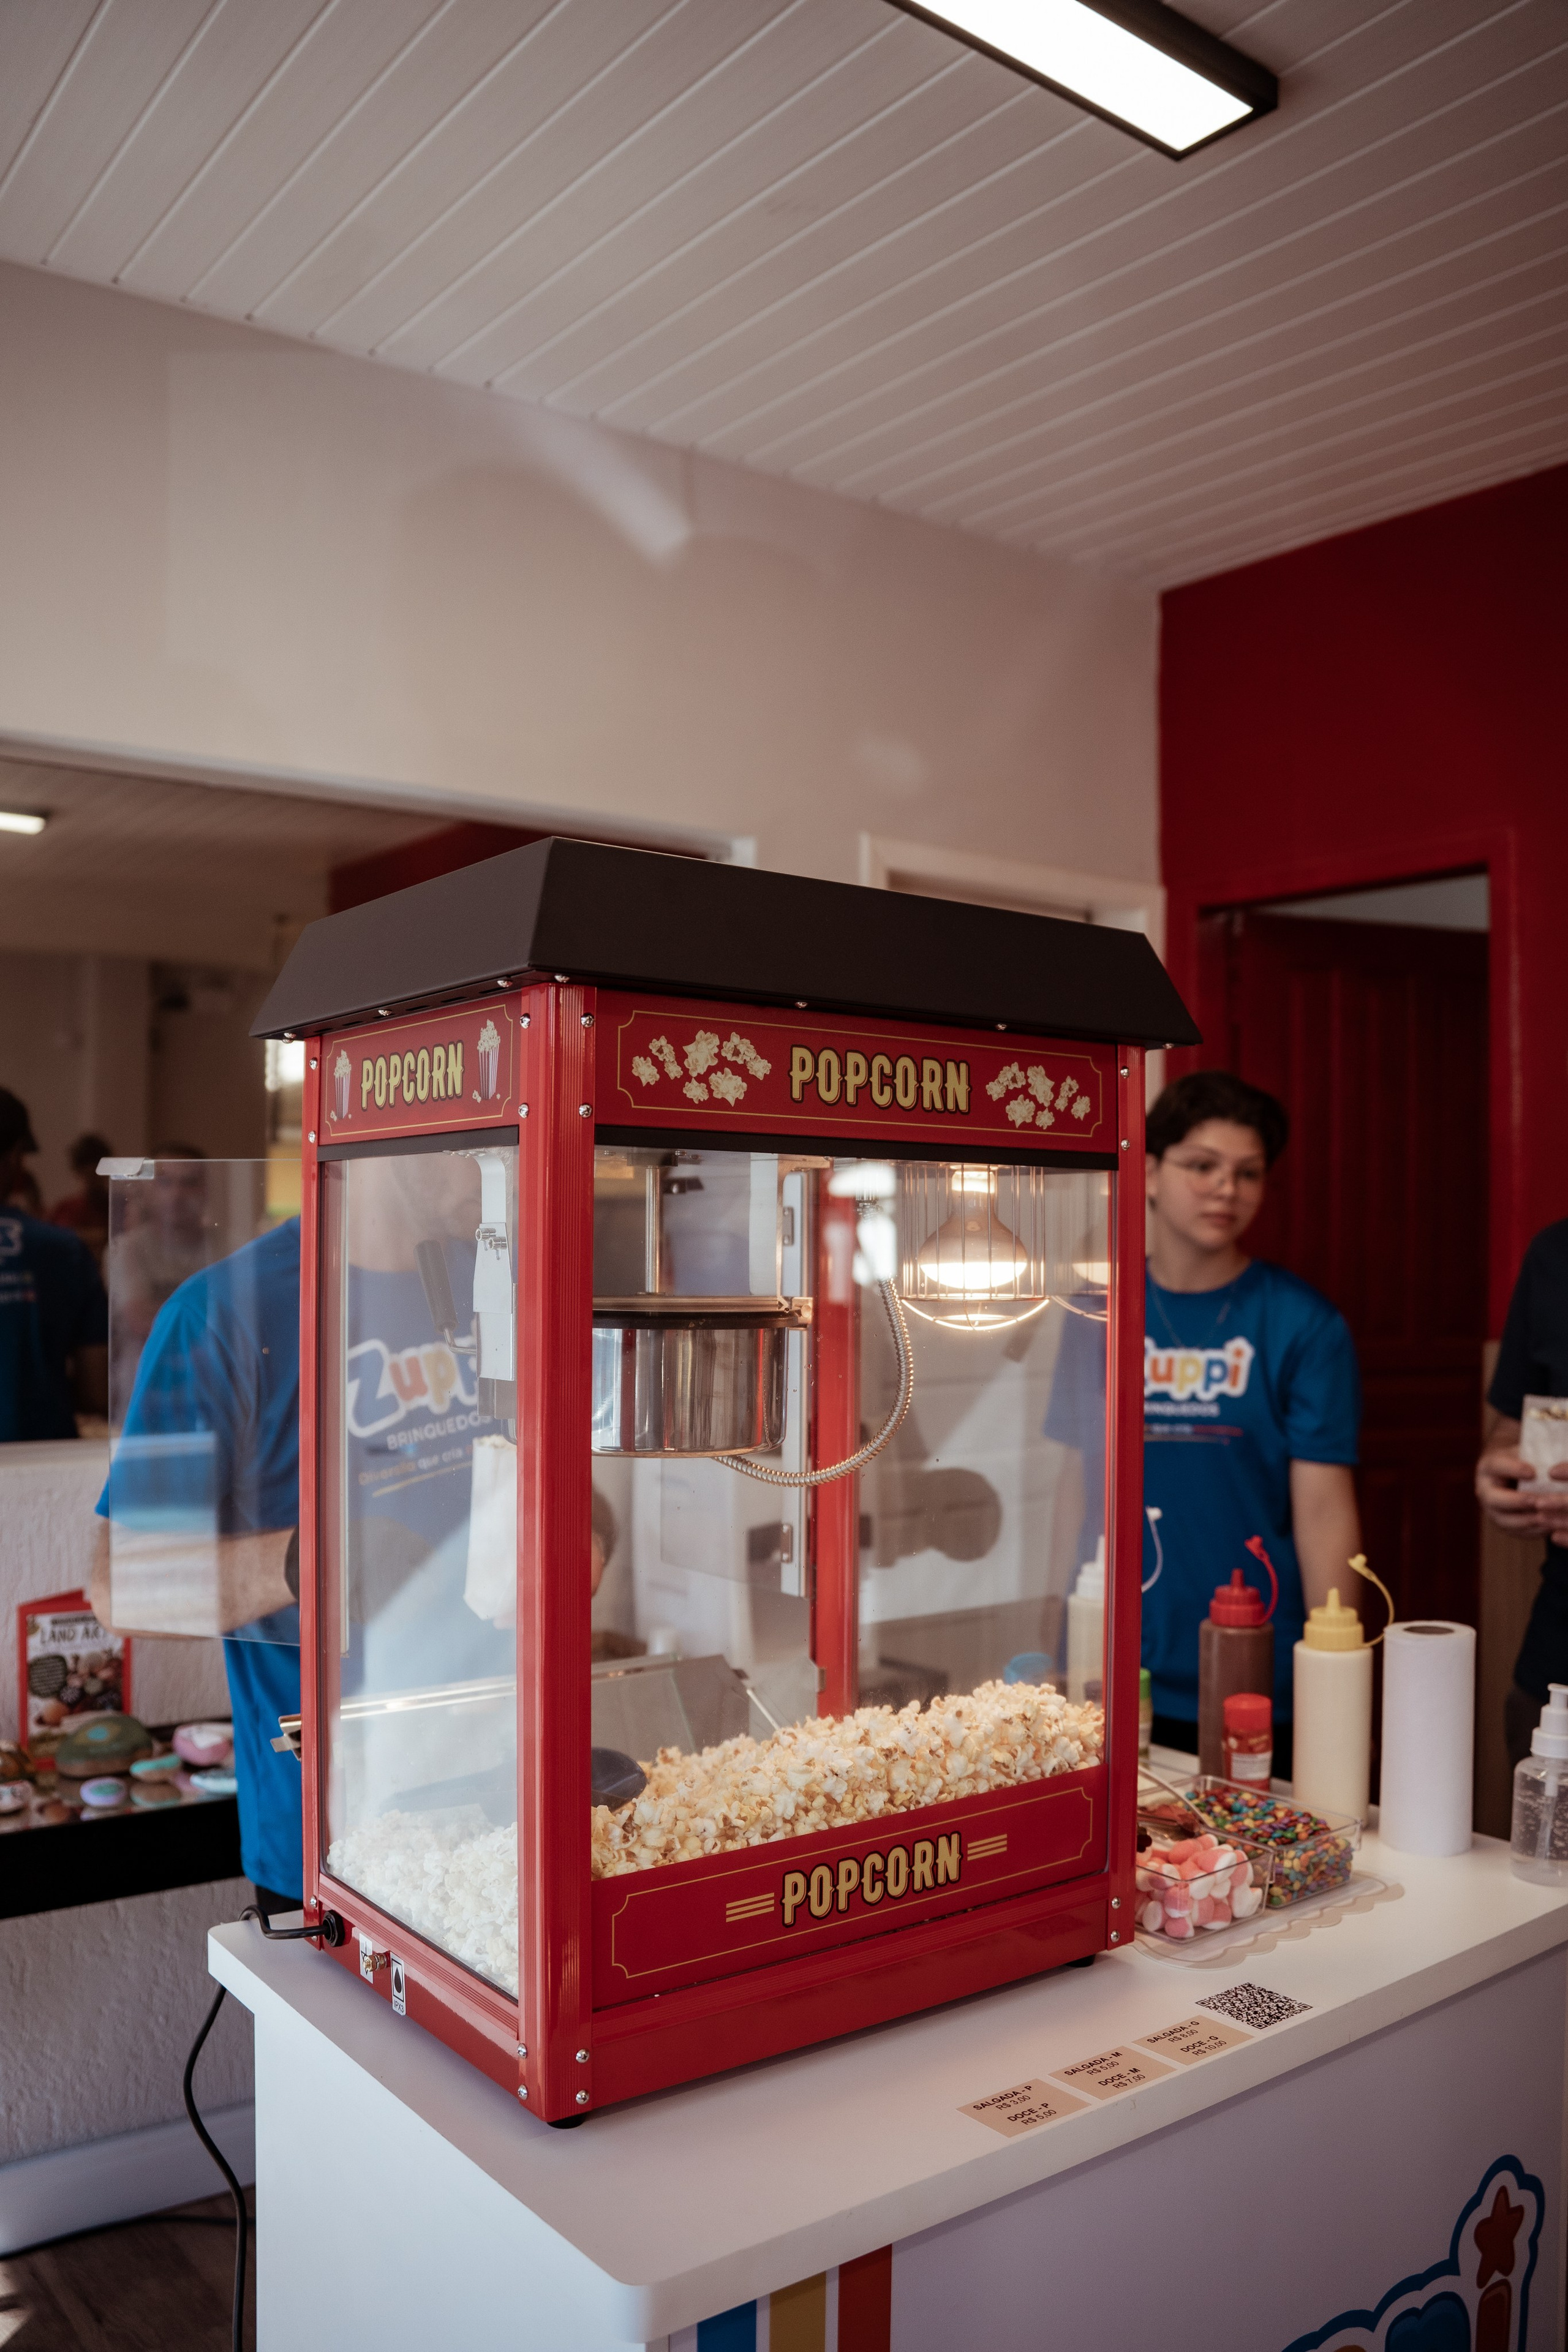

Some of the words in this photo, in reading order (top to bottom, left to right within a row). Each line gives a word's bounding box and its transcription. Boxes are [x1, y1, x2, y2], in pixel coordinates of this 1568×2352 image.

[361, 1040, 464, 1110] POPCORN
[790, 1044, 970, 1114] POPCORN
[1144, 1343, 1247, 1395] uppi
[782, 1831, 962, 1927] POPCORN
[394, 2000, 404, 2013] IPX3
[1147, 2026, 1189, 2043] SALGADA
[1180, 2029, 1199, 2038] 8,00
[1180, 2040, 1207, 2052] DOCE
[1204, 2040, 1227, 2051] 10,00
[1064, 2057, 1110, 2076] SALGADA
[1099, 2061, 1120, 2070] 5,00
[1098, 2073, 1127, 2086] DOCE
[1125, 2074, 1145, 2084] 7,00
[973, 2090, 1022, 2110] SALGADA
[995, 2102, 1011, 2111] R$
[1009, 2095, 1031, 2105] 3,00
[1006, 2108, 1038, 2122] DOCE
[1020, 2117, 1037, 2125] R$
[1035, 2109, 1057, 2120] 5,00
